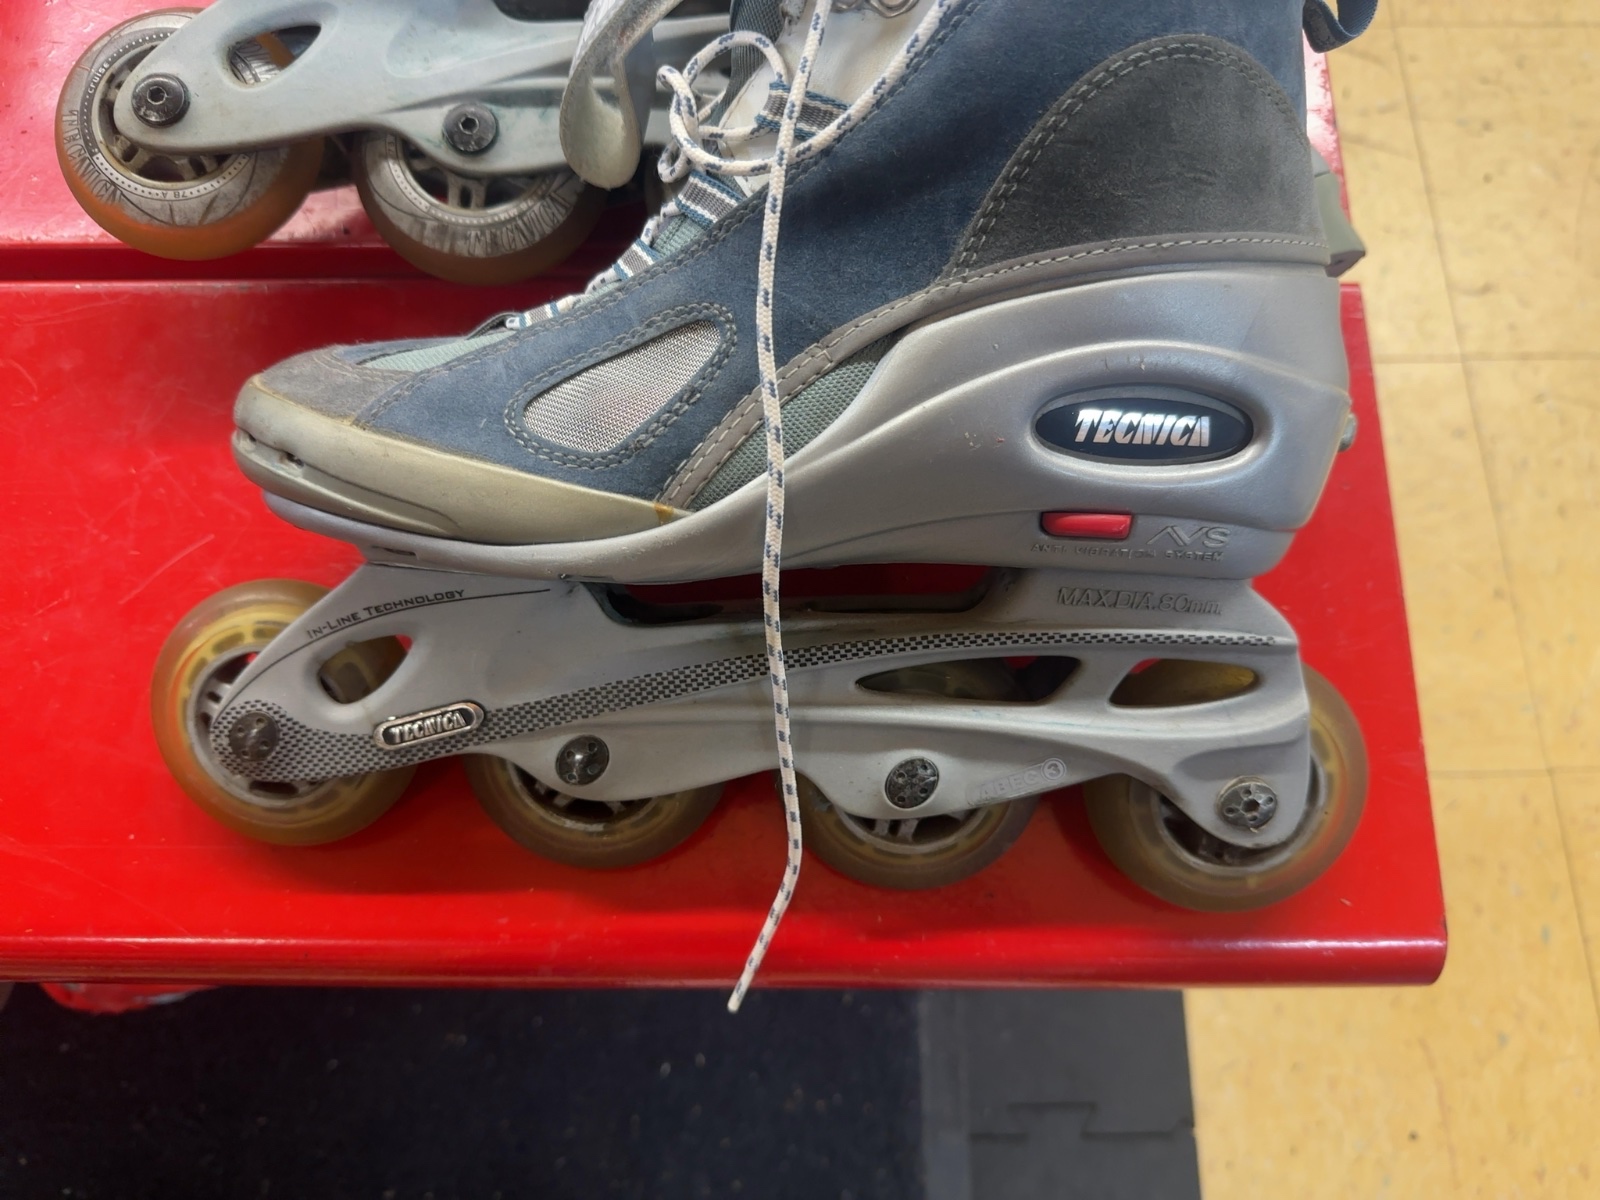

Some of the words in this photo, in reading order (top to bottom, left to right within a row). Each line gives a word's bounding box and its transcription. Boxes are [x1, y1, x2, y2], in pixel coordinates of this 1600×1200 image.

[88, 62, 111, 95] cruise
[1074, 408, 1211, 447] TECNICA
[1146, 525, 1231, 549] AVS
[1165, 549, 1224, 561] SYSTEM
[306, 612, 362, 640] IN-LINE
[362, 589, 466, 617] TECHNOLOGY
[390, 709, 468, 744] TECNICA
[979, 769, 1040, 799] ABEC
